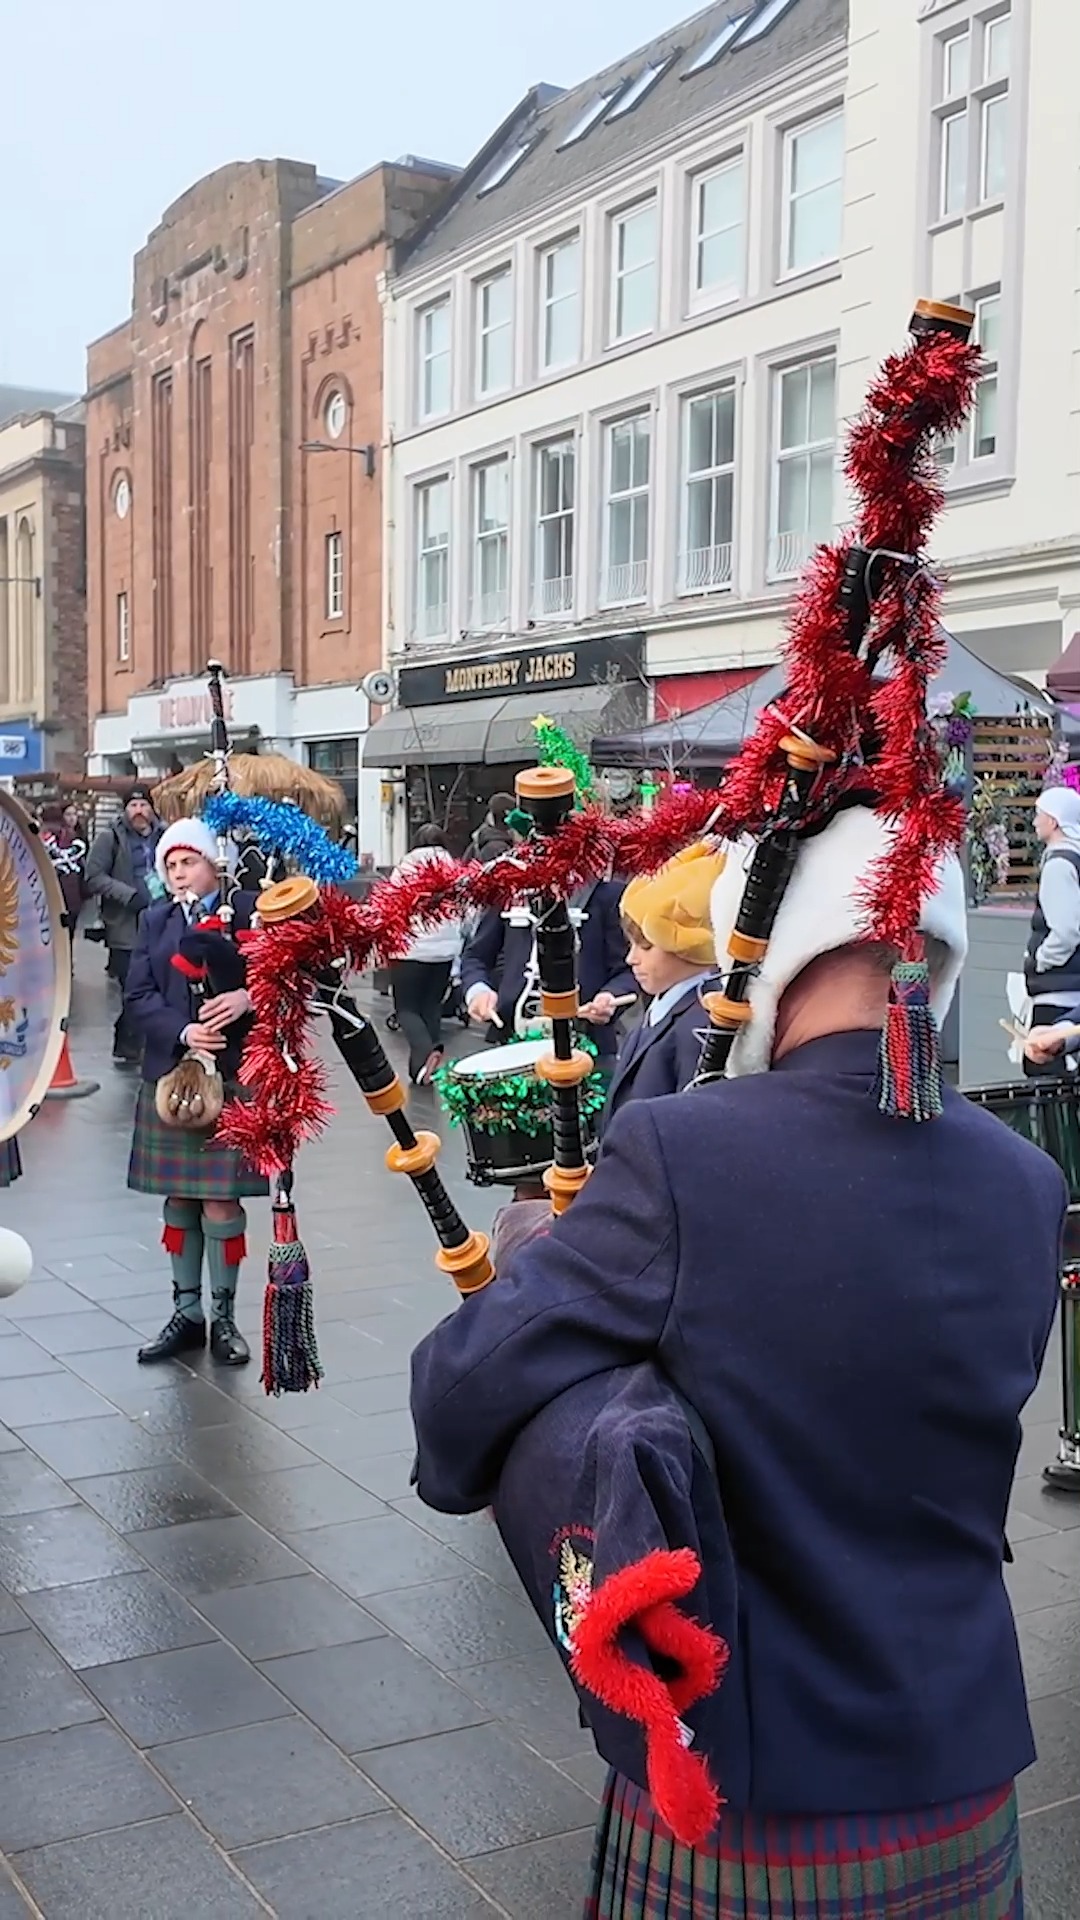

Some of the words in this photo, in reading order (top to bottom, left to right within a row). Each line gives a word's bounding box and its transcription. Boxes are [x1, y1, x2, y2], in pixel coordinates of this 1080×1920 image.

[445, 660, 521, 693] MONTEREY
[525, 651, 576, 683] JACKS
[0, 816, 28, 868] PIPE
[28, 869, 50, 946] BAND
